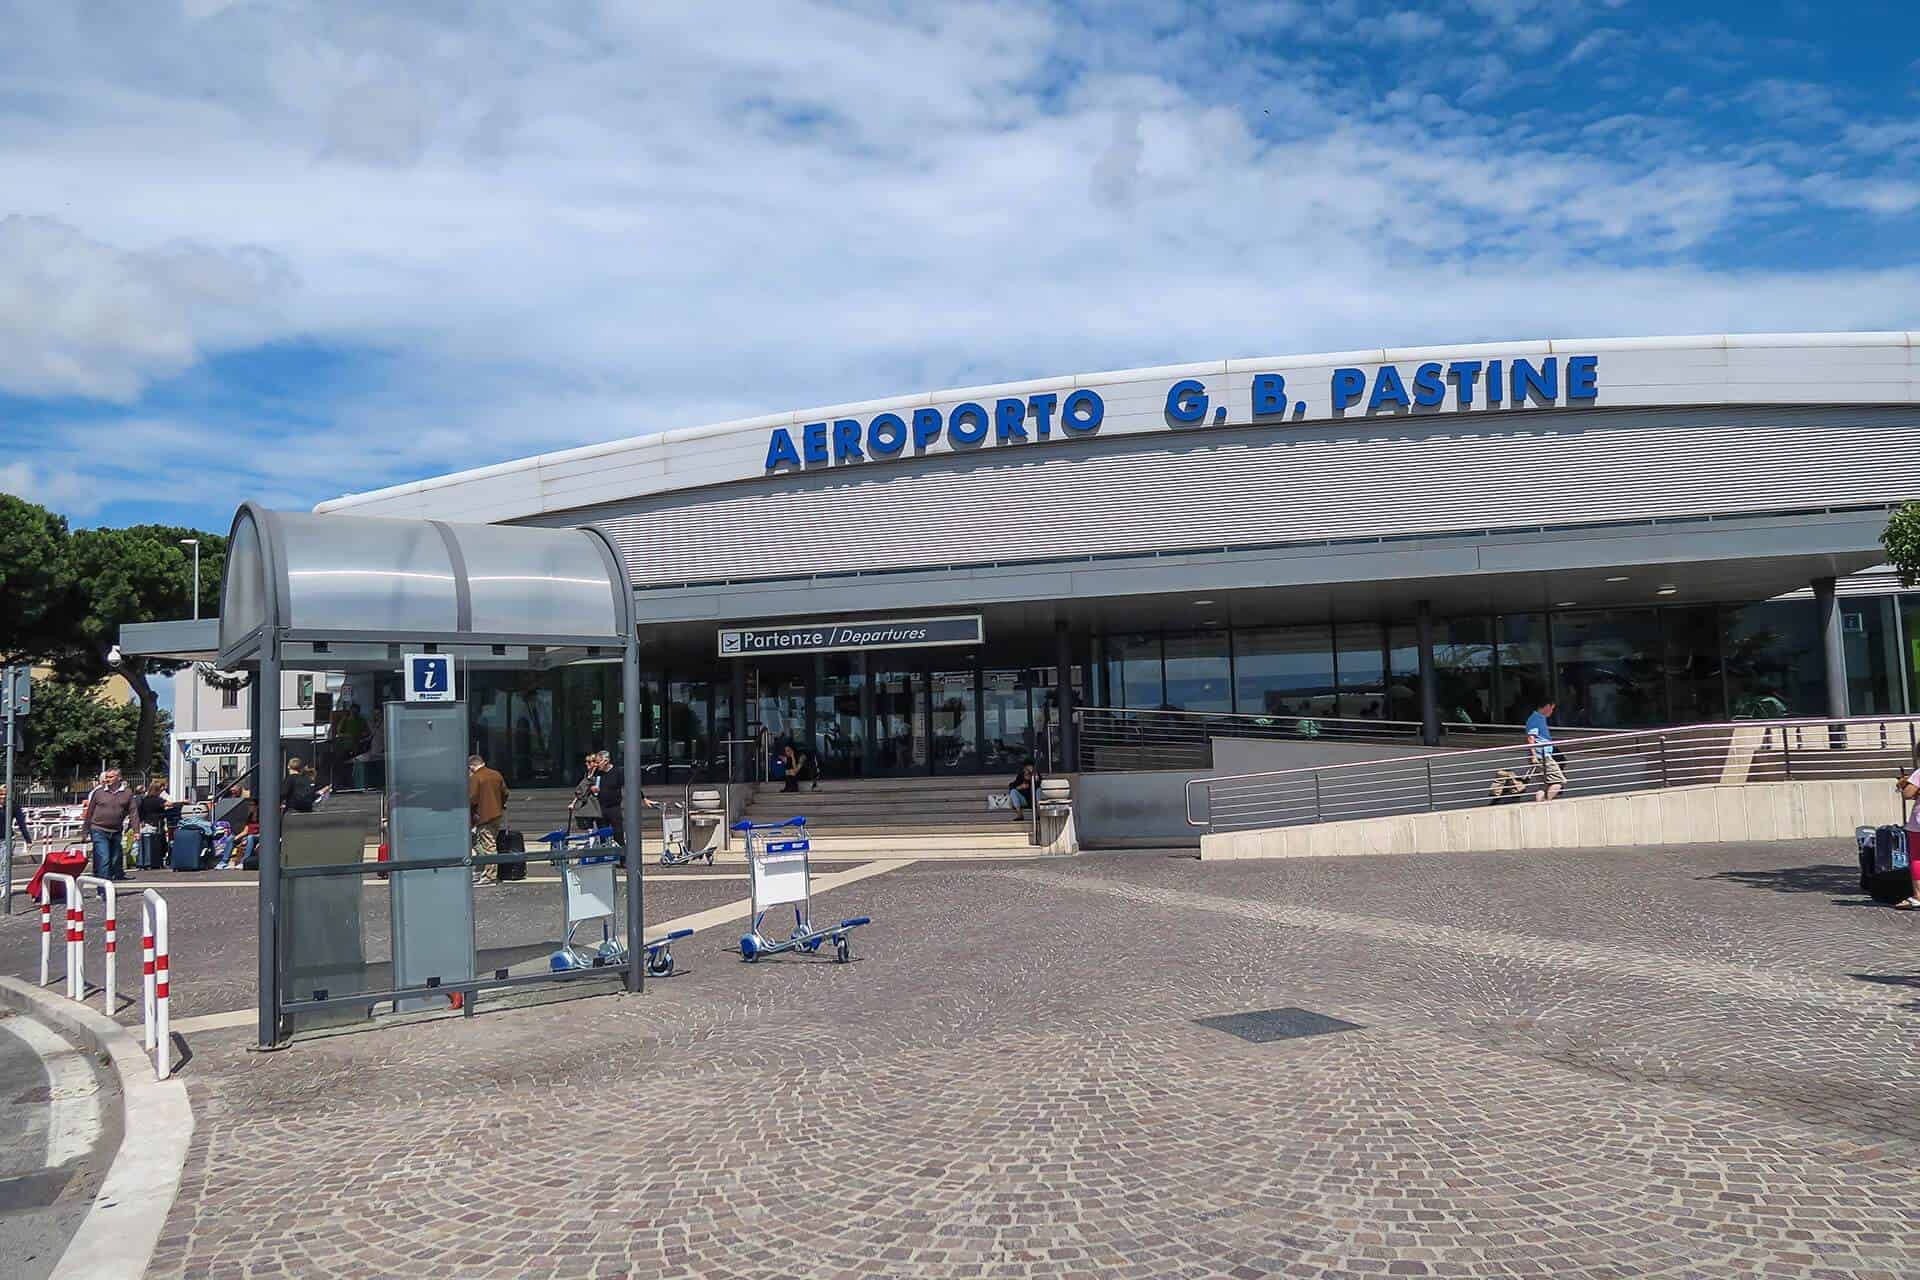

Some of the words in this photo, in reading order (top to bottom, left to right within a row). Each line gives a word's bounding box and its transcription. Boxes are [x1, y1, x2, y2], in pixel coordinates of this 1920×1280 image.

[765, 389, 1105, 469] AEROPORTO
[1167, 379, 1227, 421] G.
[1253, 374, 1306, 415] B.
[1333, 356, 1598, 410] PASTINE
[744, 631, 823, 648] Partenze
[839, 627, 926, 643] Departures
[204, 743, 230, 753] Arrivi
[238, 744, 251, 753] Arr
